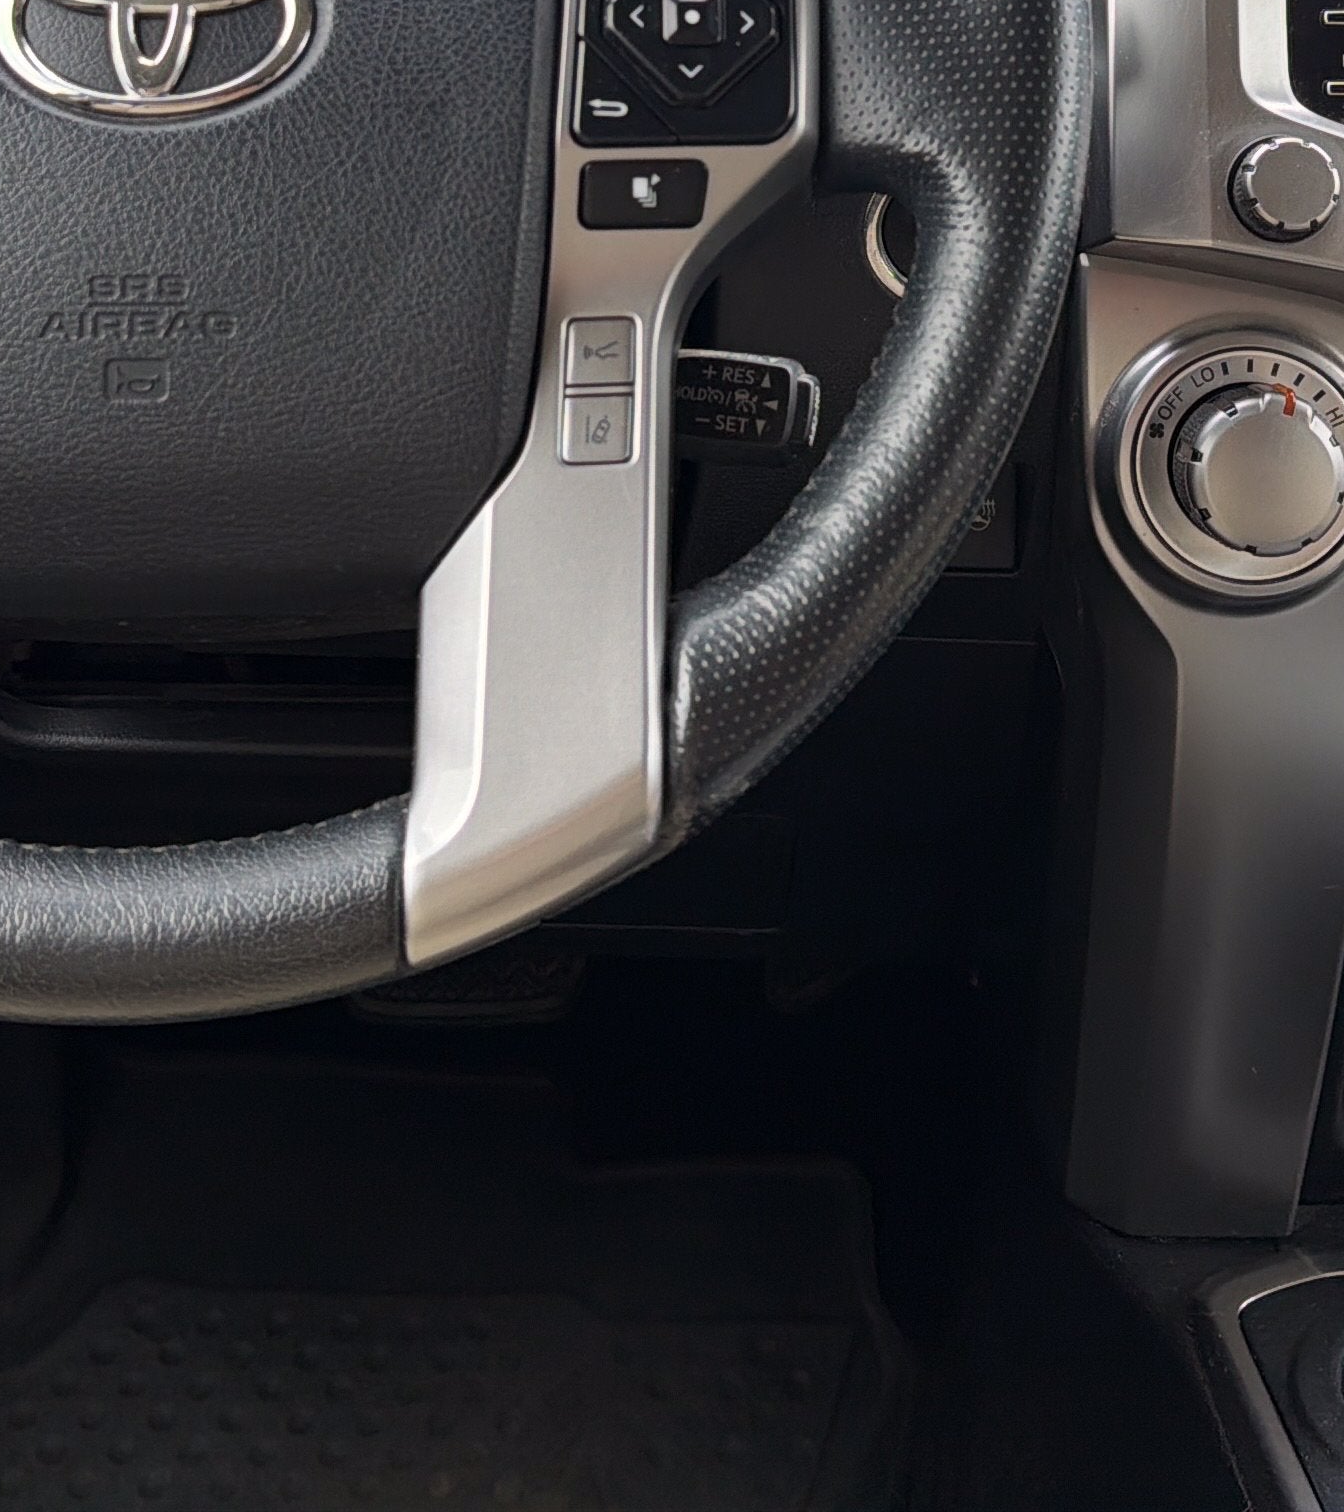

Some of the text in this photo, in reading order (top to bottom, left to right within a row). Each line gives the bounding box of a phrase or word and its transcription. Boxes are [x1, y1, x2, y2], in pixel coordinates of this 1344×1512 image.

[40, 311, 238, 339] AIRBAG
[722, 366, 755, 385] RES
[1190, 366, 1216, 389] LO
[678, 386, 708, 401] OLD
[1157, 385, 1185, 421] OFF
[715, 414, 749, 433] SET
